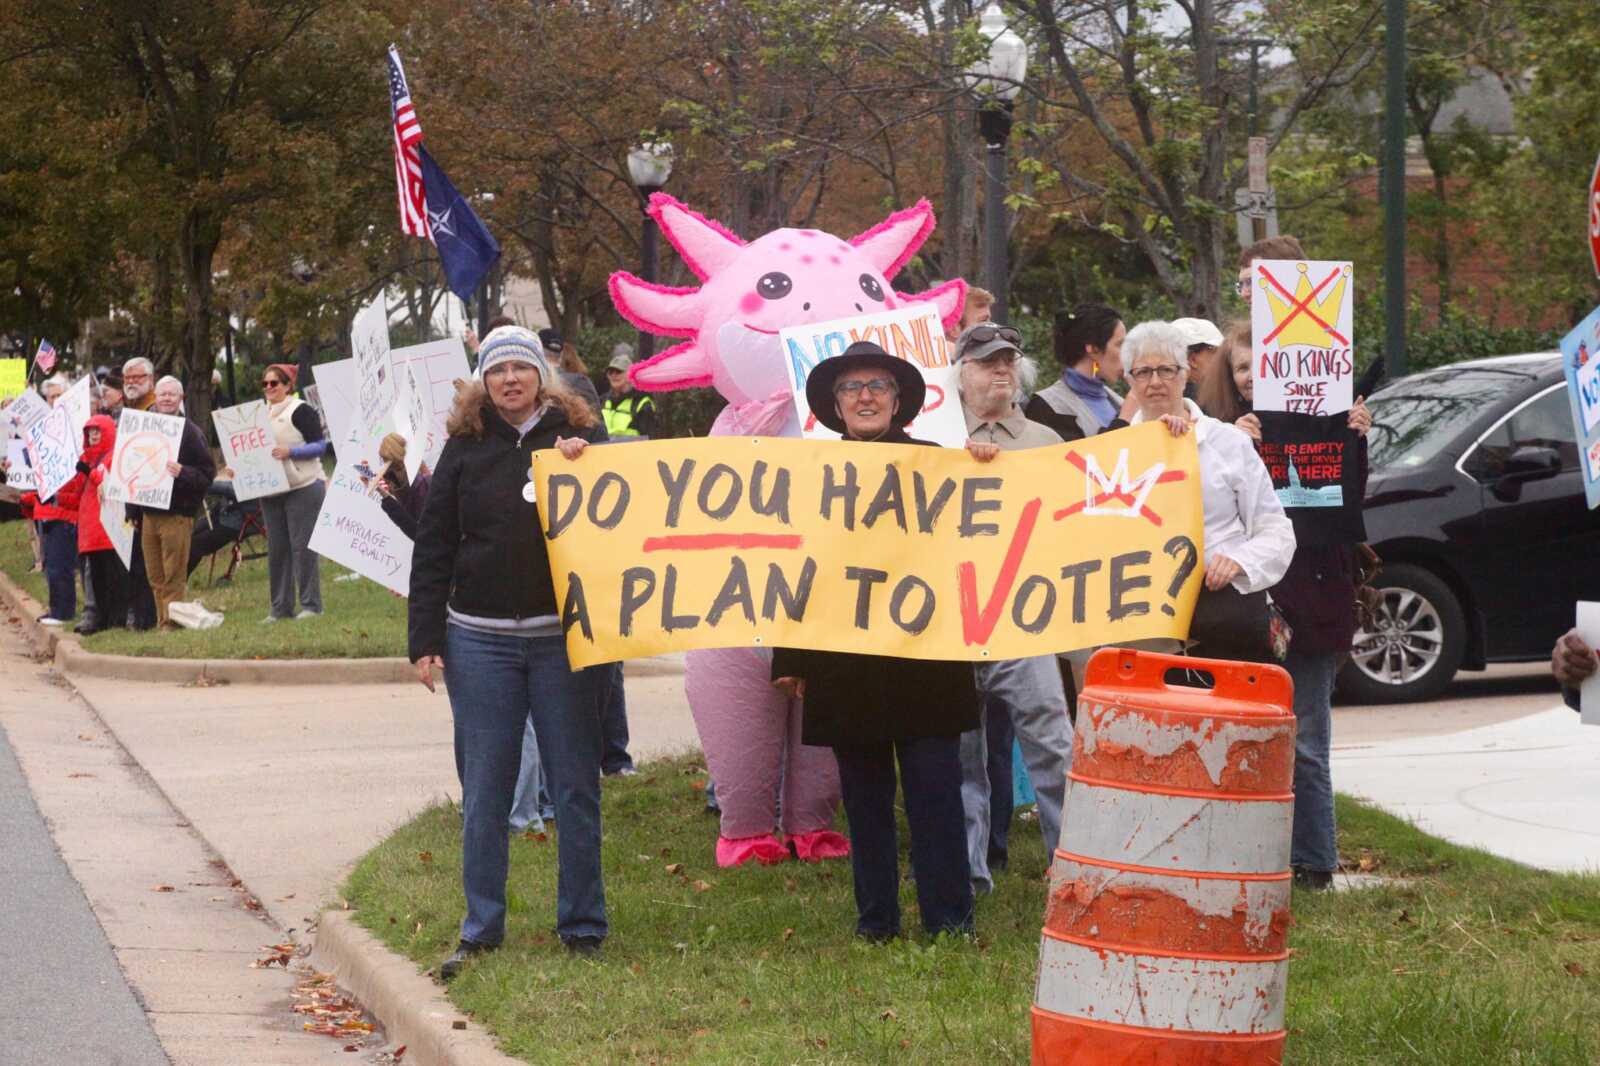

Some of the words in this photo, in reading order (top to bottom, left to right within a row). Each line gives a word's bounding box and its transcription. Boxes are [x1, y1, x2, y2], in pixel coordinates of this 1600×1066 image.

[1260, 351, 1290, 379] NO
[1296, 349, 1352, 382] KINGS
[1283, 381, 1328, 397] SINCE
[1286, 398, 1328, 416] 1776
[122, 415, 139, 433] NO
[142, 417, 180, 437] KINGS
[230, 428, 273, 457] FREE
[1284, 444, 1297, 455] IS
[1299, 442, 1344, 455] EMPTY
[1311, 455, 1342, 464] DEVILS
[1299, 465, 1342, 480] HERE
[545, 471, 631, 540] DO
[657, 458, 791, 528] YOU
[819, 461, 1003, 538] HAVE
[335, 516, 392, 549] MARRIAGE
[350, 538, 403, 577] EQUALITY
[561, 571, 594, 644] A
[619, 555, 817, 637] PLAN
[845, 565, 936, 637] TO
[956, 497, 1198, 646] VOTE?
